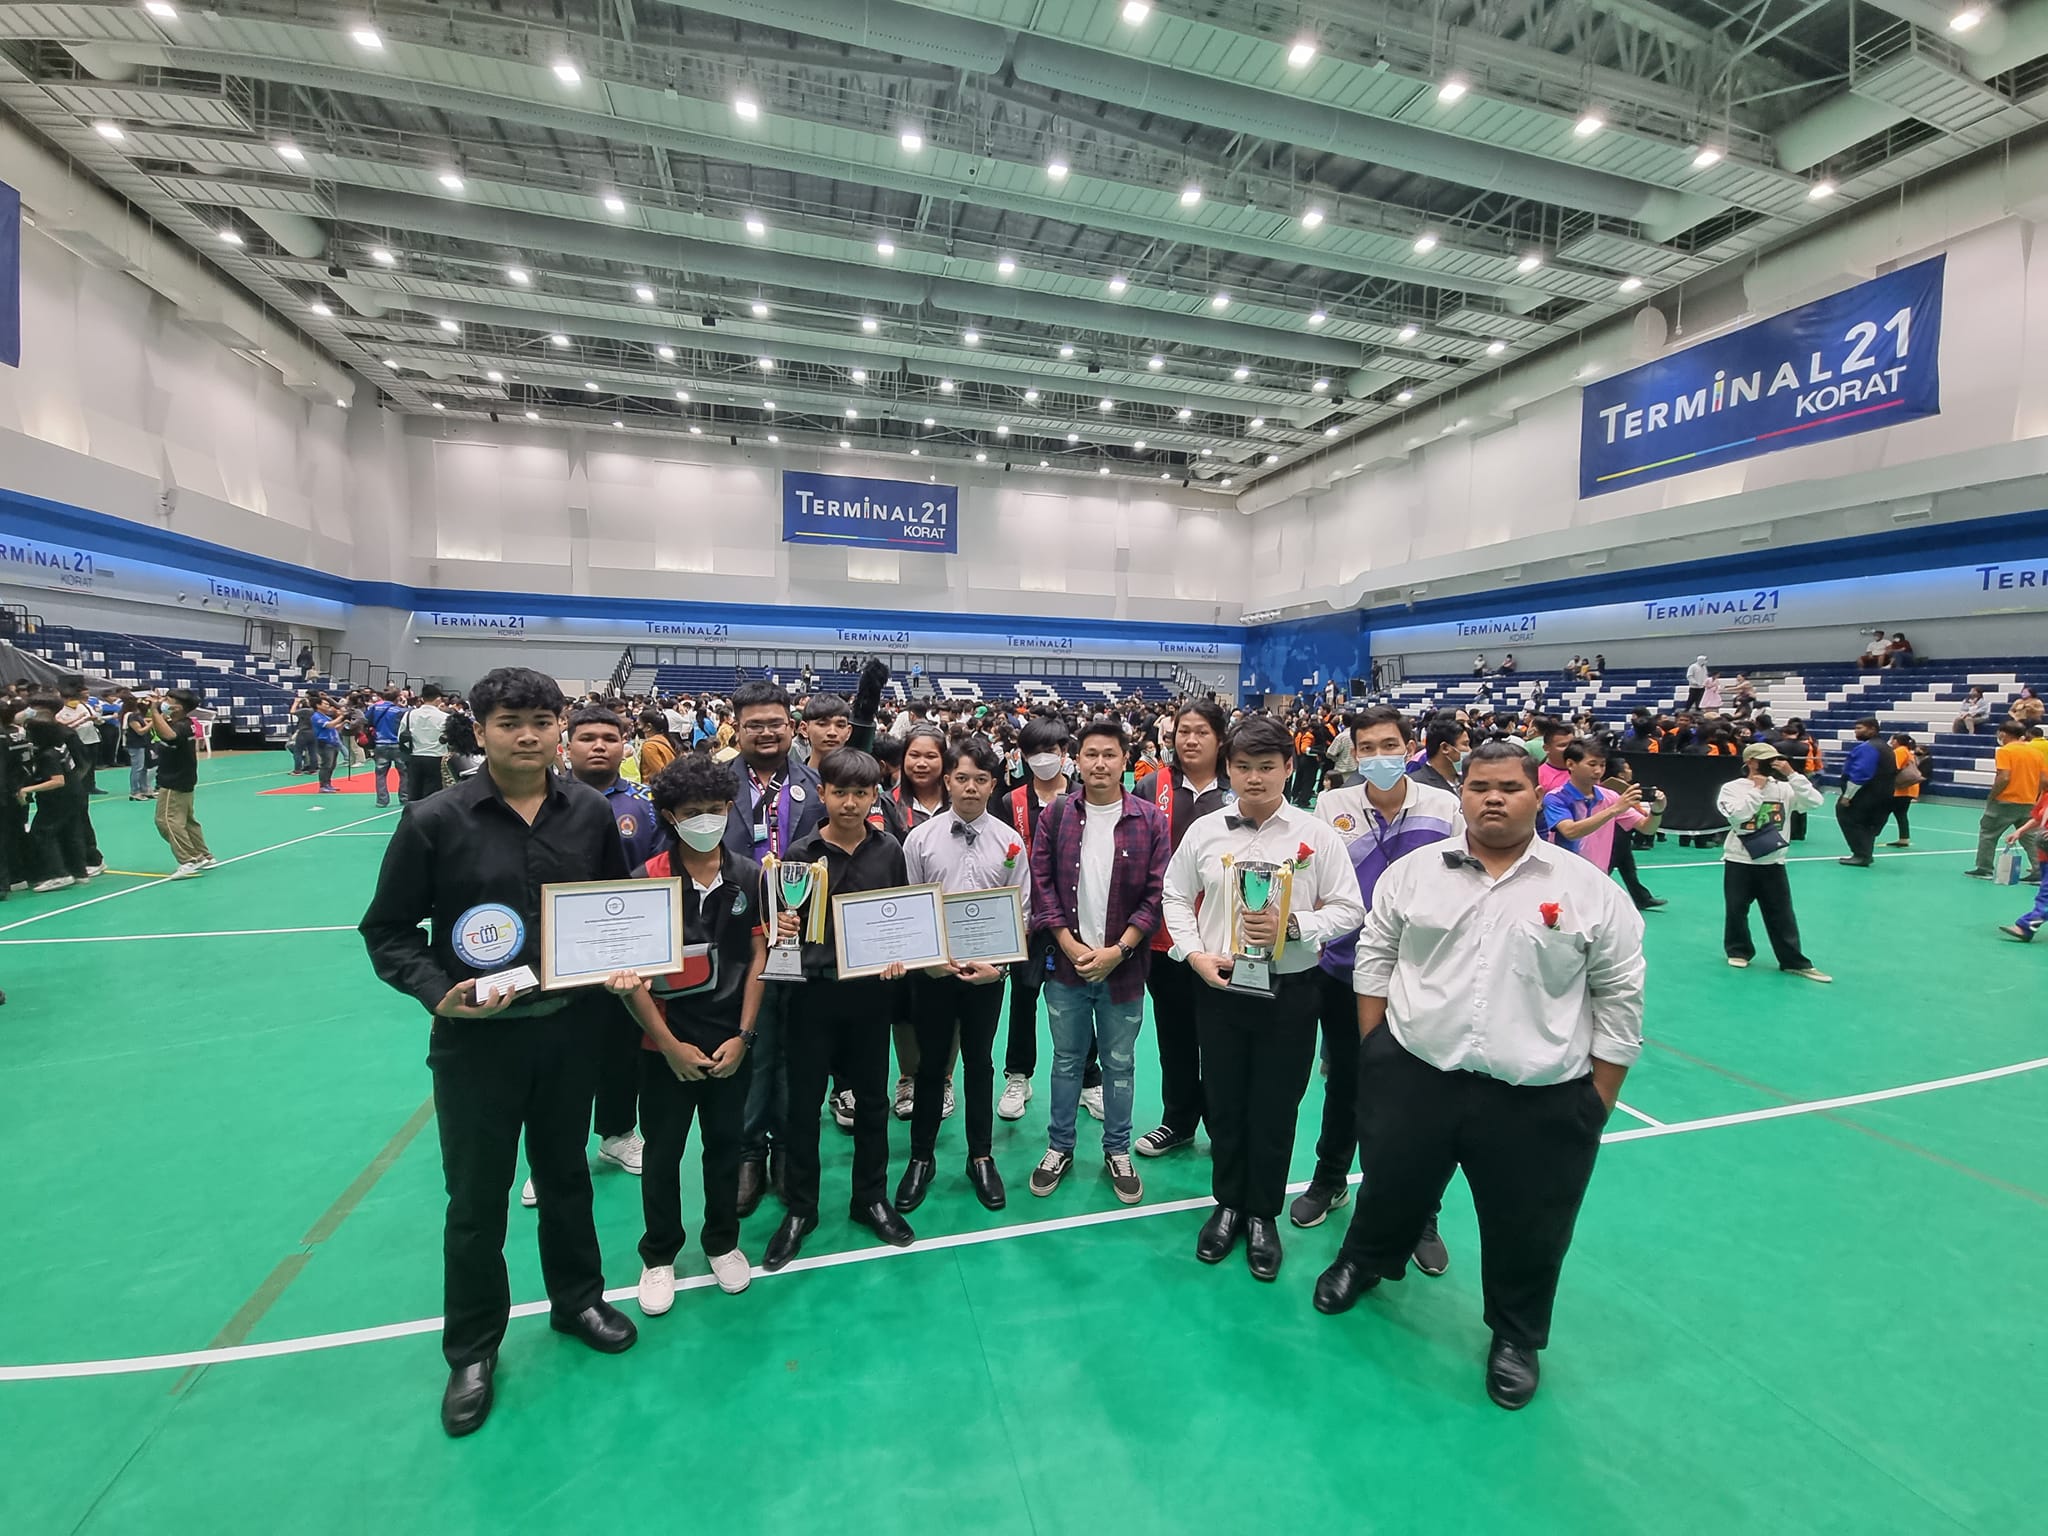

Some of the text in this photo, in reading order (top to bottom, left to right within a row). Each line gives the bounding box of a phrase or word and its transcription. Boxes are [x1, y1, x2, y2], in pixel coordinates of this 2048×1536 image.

[1794, 365, 1908, 418] KORAT
[903, 525, 946, 539] KORAT
[60, 573, 94, 588] KORAT
[1975, 566, 2048, 590] TER
[1733, 612, 1778, 626] KORAT
[1508, 632, 1535, 642] KORAT
[1217, 674, 1226, 687] 2
